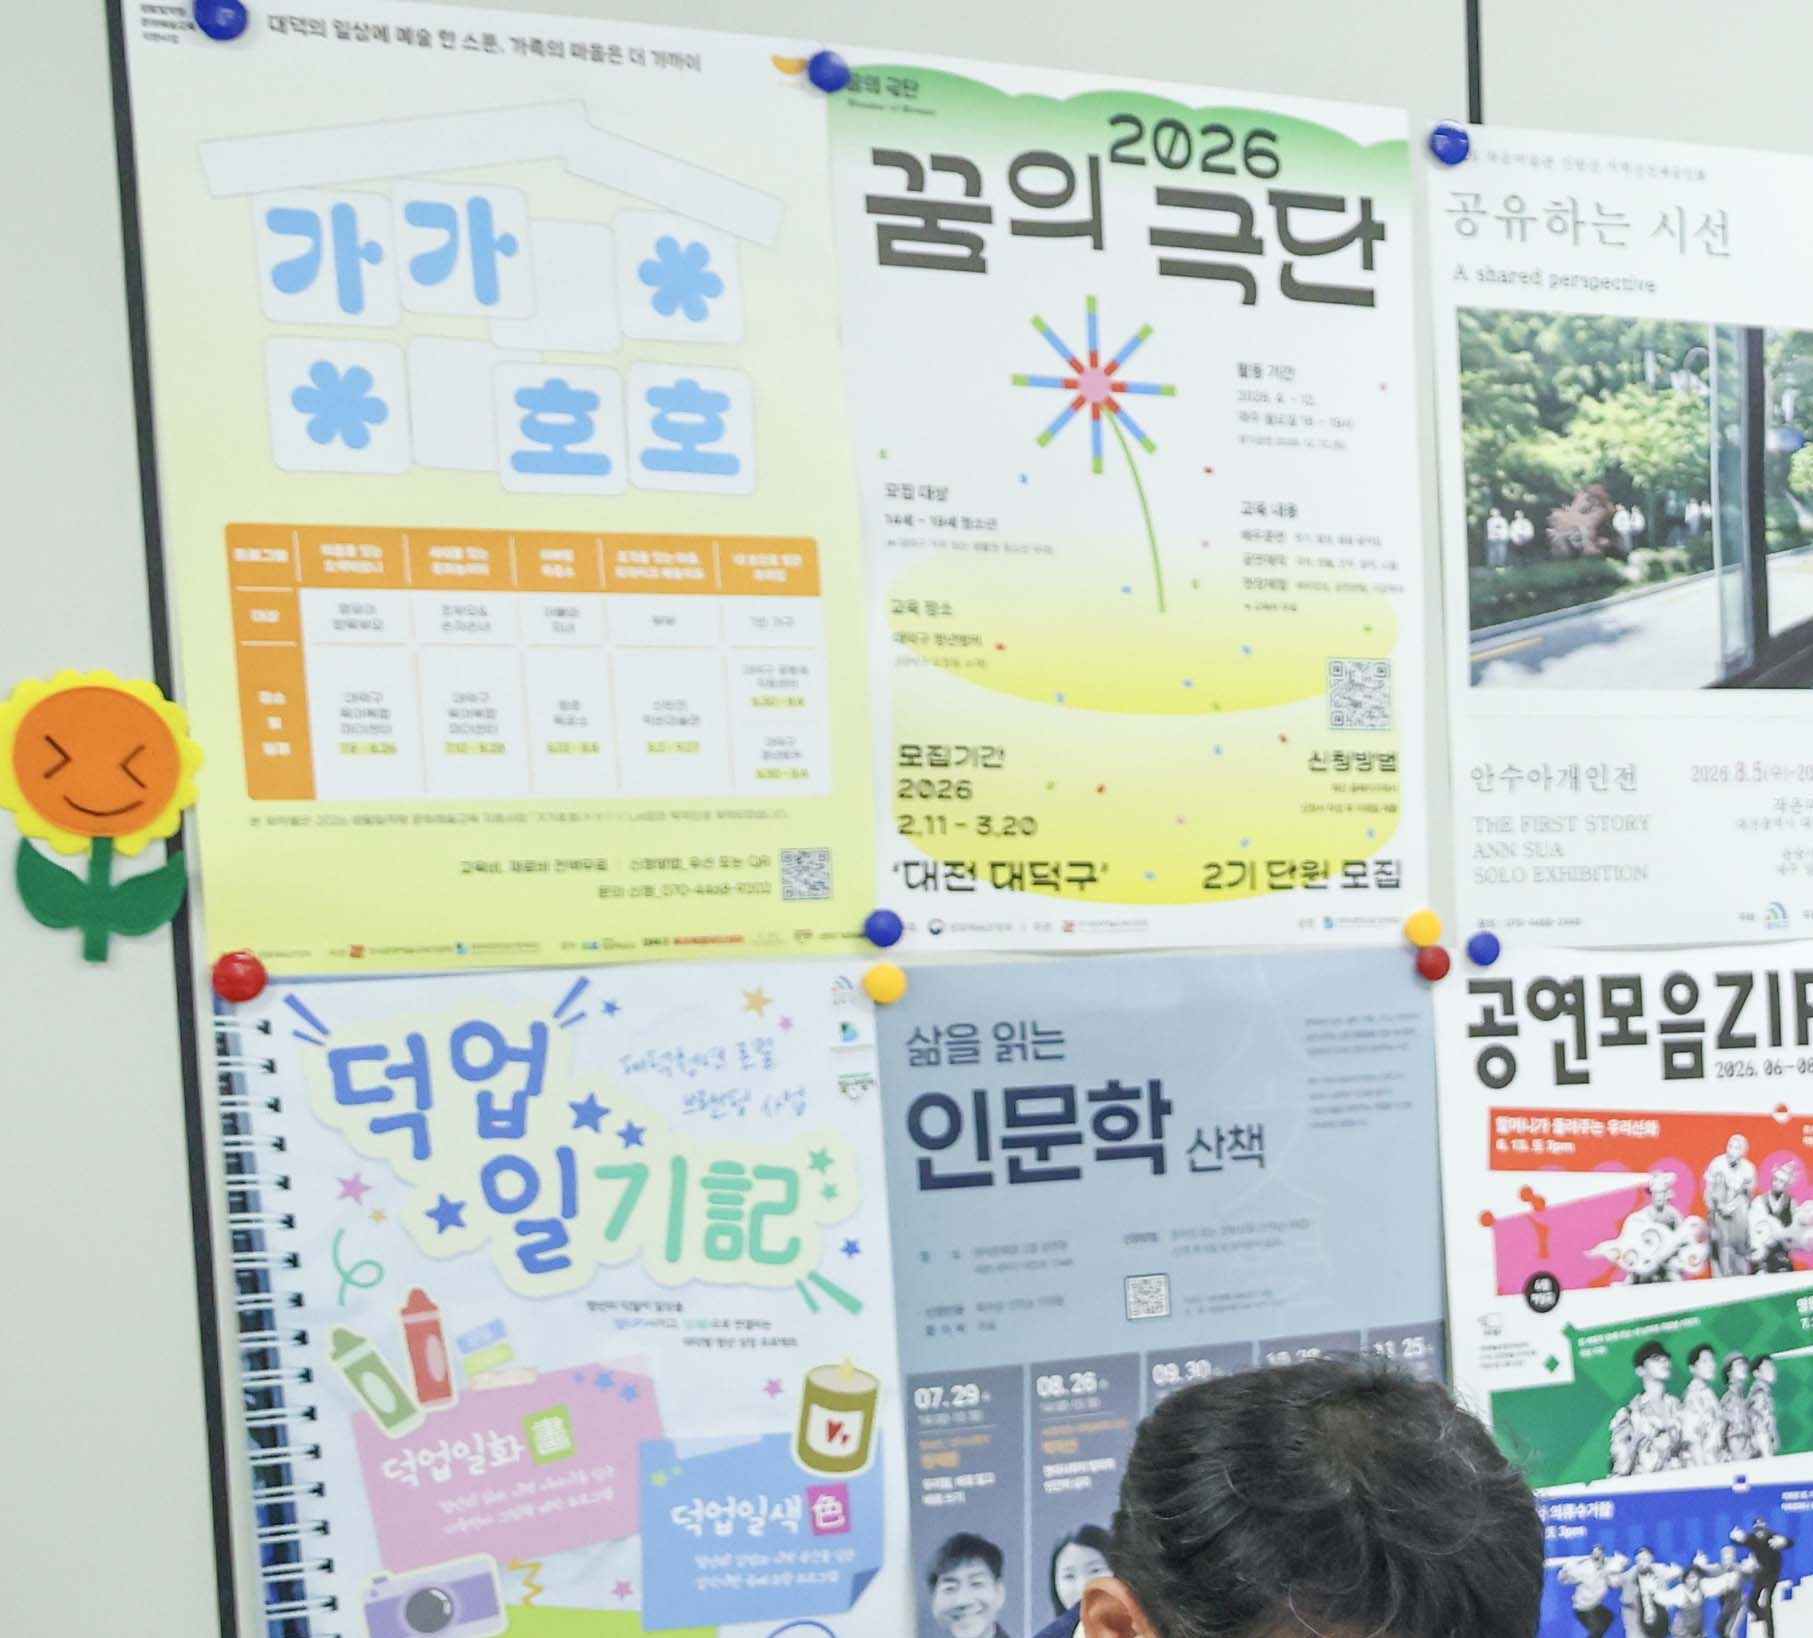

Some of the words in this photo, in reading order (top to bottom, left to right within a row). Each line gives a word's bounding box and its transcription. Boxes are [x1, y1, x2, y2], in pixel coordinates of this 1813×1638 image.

[1107, 112, 1281, 180] 2026
[865, 147, 1104, 275] 꿈의
[1149, 184, 1386, 308] 극단
[1444, 190, 1631, 249] 공유하는
[1649, 204, 1733, 258] 시선
[1453, 265, 1470, 282] A
[1476, 263, 1542, 288] shared
[1548, 270, 1657, 295] perspective
[897, 744, 1006, 770] 모집기간
[897, 780, 974, 801] 2026
[897, 815, 950, 837] 2.11
[976, 815, 1038, 837] 3.20
[1472, 815, 1513, 833] THE
[1520, 815, 1579, 833] FIRST
[1584, 814, 1651, 833] STORY
[1472, 842, 1518, 860] ANN
[1523, 841, 1565, 859] SUA
[1203, 860, 1258, 891] 2기
[1265, 861, 1331, 890] 단원
[1340, 861, 1402, 891] 모집
[1473, 866, 1526, 884] SOLO
[1533, 864, 1650, 883] EXHIBITION
[905, 1022, 981, 1067] 삶을
[992, 1019, 1066, 1064] 읽는
[328, 1020, 548, 1161] 덕업
[906, 1079, 1173, 1192] 인문학
[1186, 1123, 1266, 1175] 산책
[913, 1383, 981, 1410] 07.29
[1036, 1370, 1098, 1398] 08.26
[670, 1494, 803, 1537] 덕업일색
[811, 1494, 847, 1530] 色
